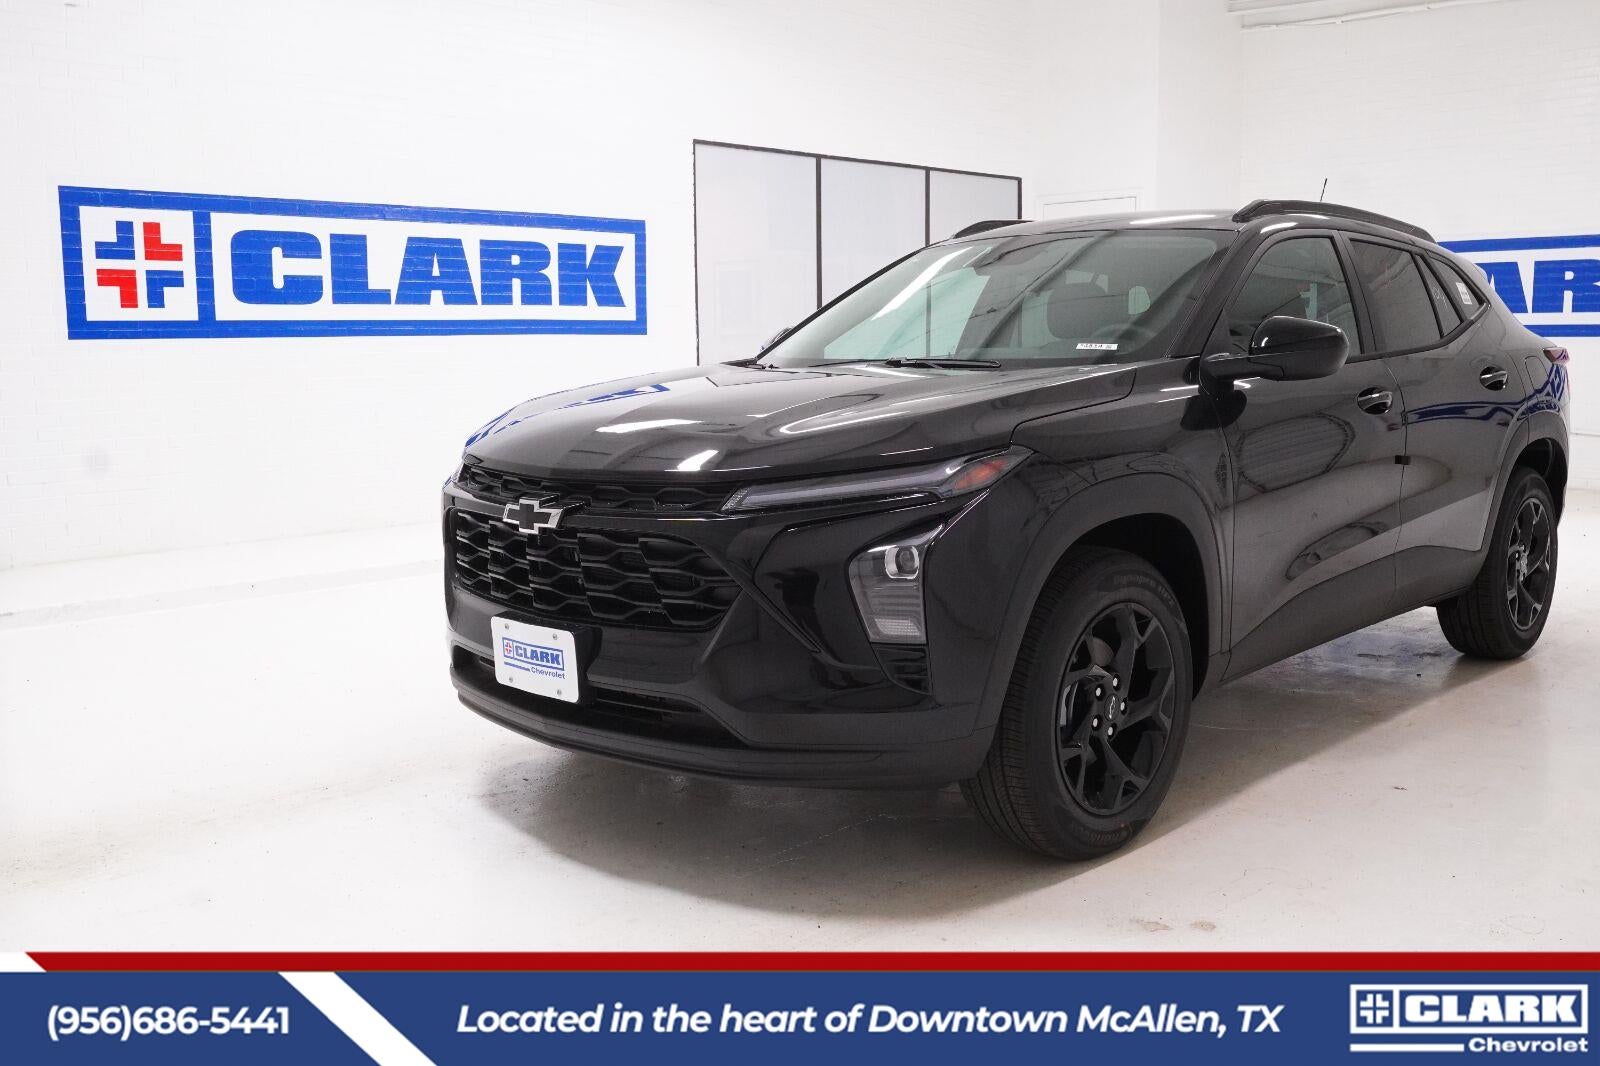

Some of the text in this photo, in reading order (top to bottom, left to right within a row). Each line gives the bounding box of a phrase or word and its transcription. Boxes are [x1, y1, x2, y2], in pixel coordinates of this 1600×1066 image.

[231, 229, 626, 308] CLARK
[514, 644, 561, 666] CLARK
[530, 666, 566, 680] Chevrolet
